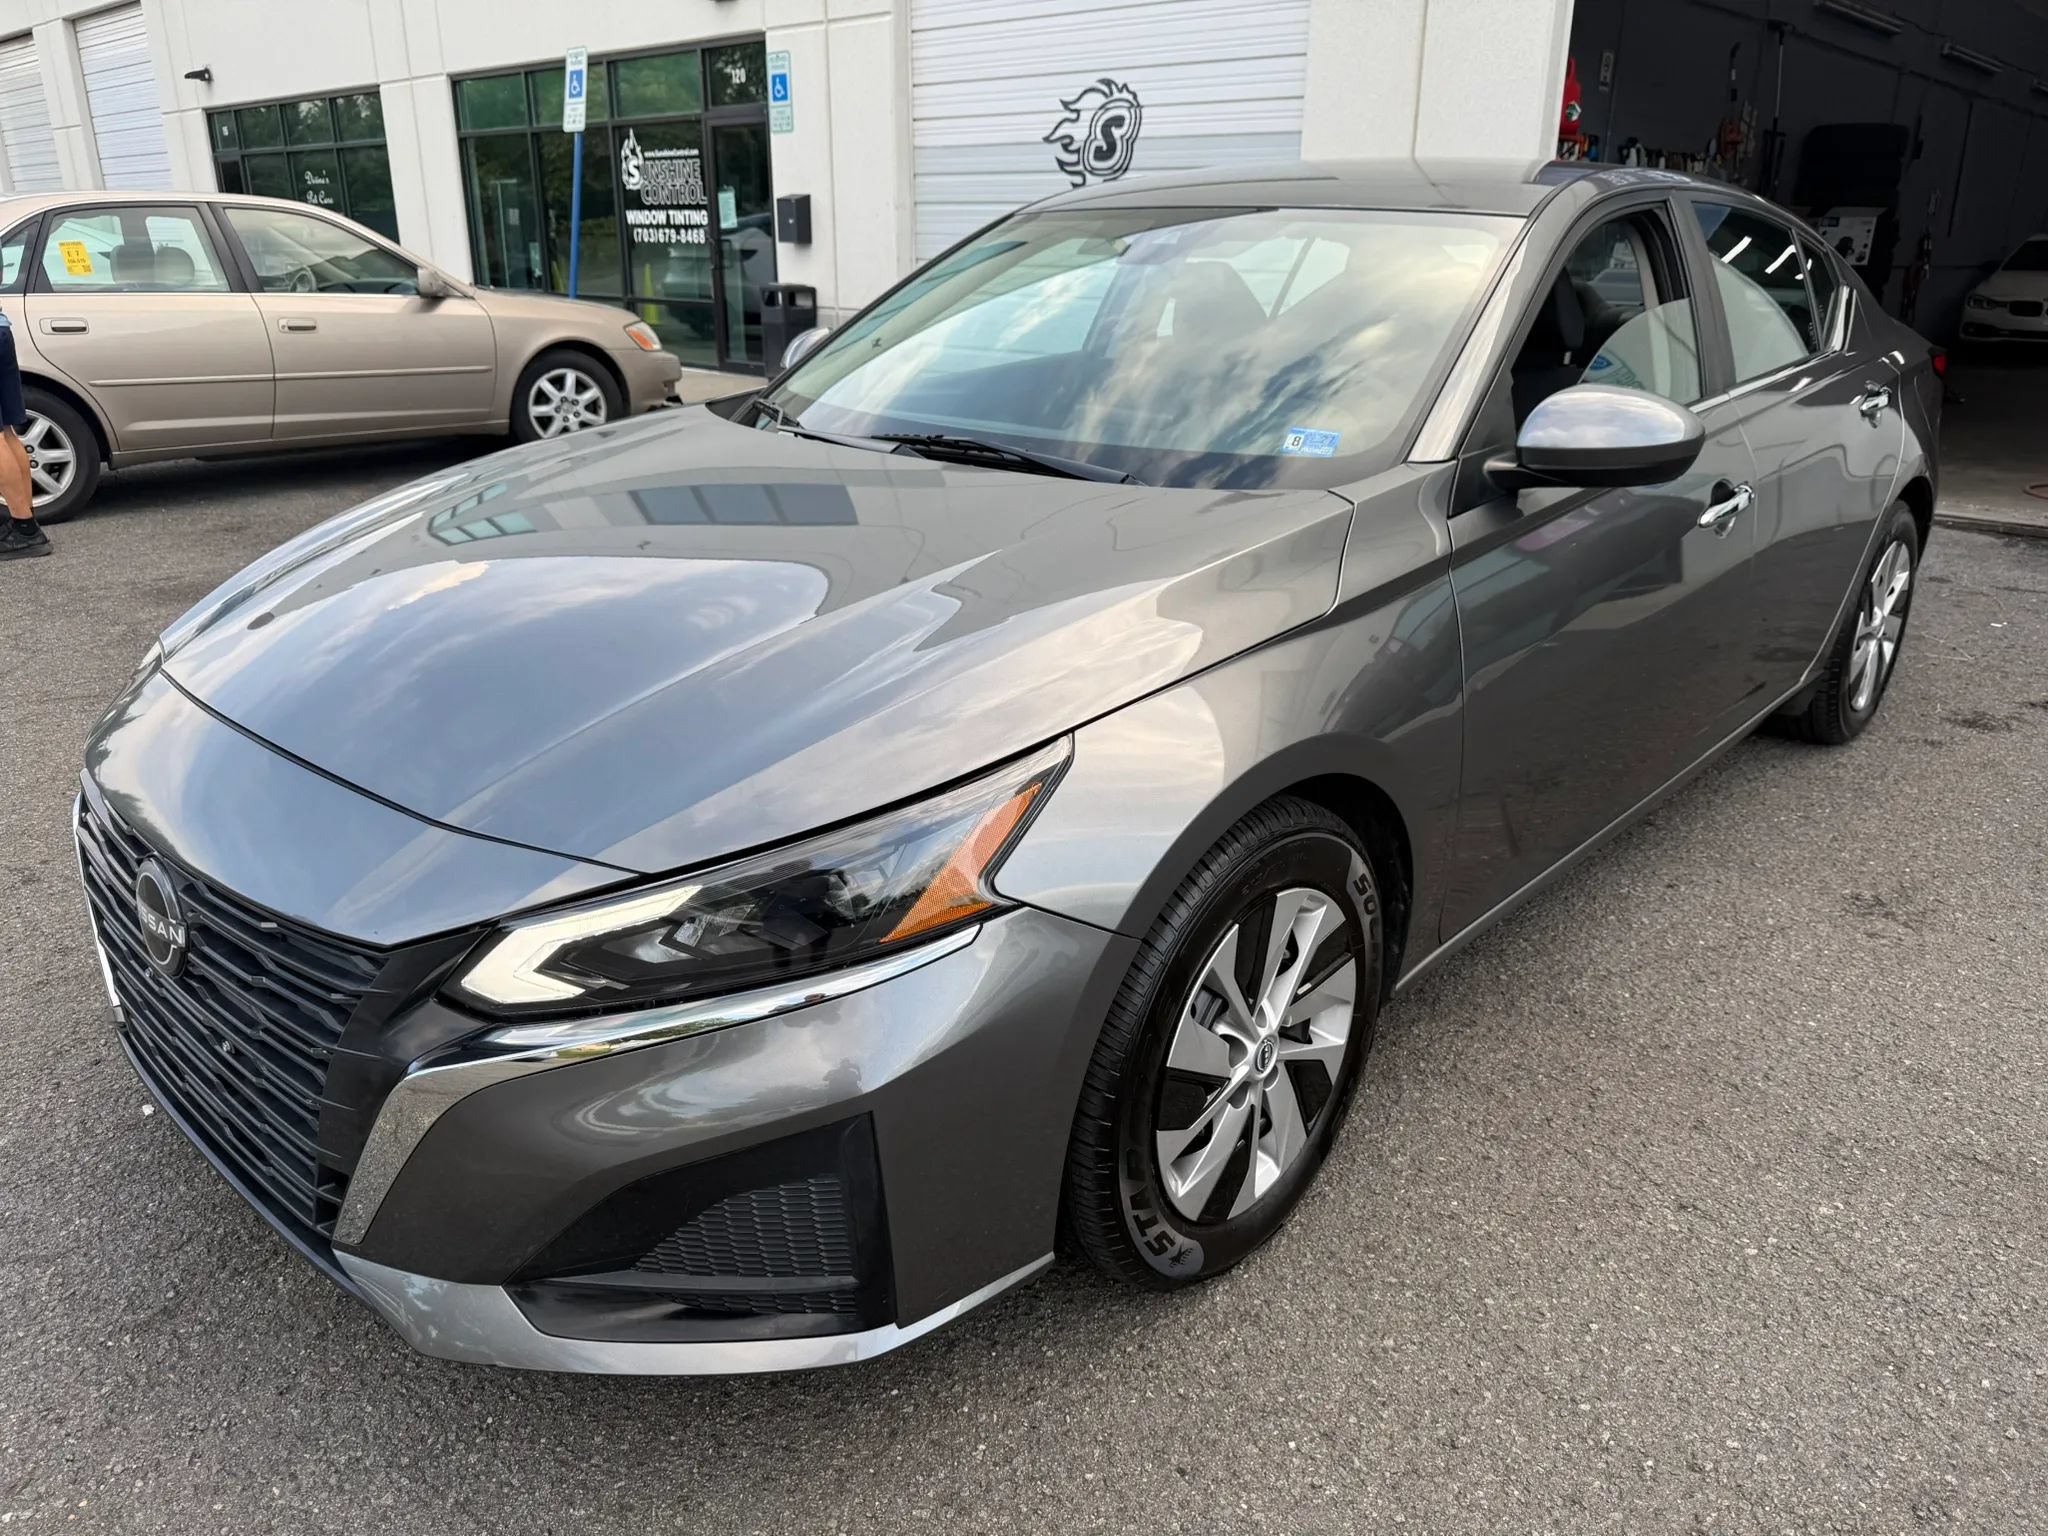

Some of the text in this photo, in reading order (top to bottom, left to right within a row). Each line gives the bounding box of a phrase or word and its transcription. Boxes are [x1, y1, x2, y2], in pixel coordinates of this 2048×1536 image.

[731, 67, 747, 84] 120
[640, 180, 708, 205] CONTROL
[625, 209, 667, 225] WINDOW
[668, 209, 708, 226] TINTING
[1292, 436, 1302, 447] 8
